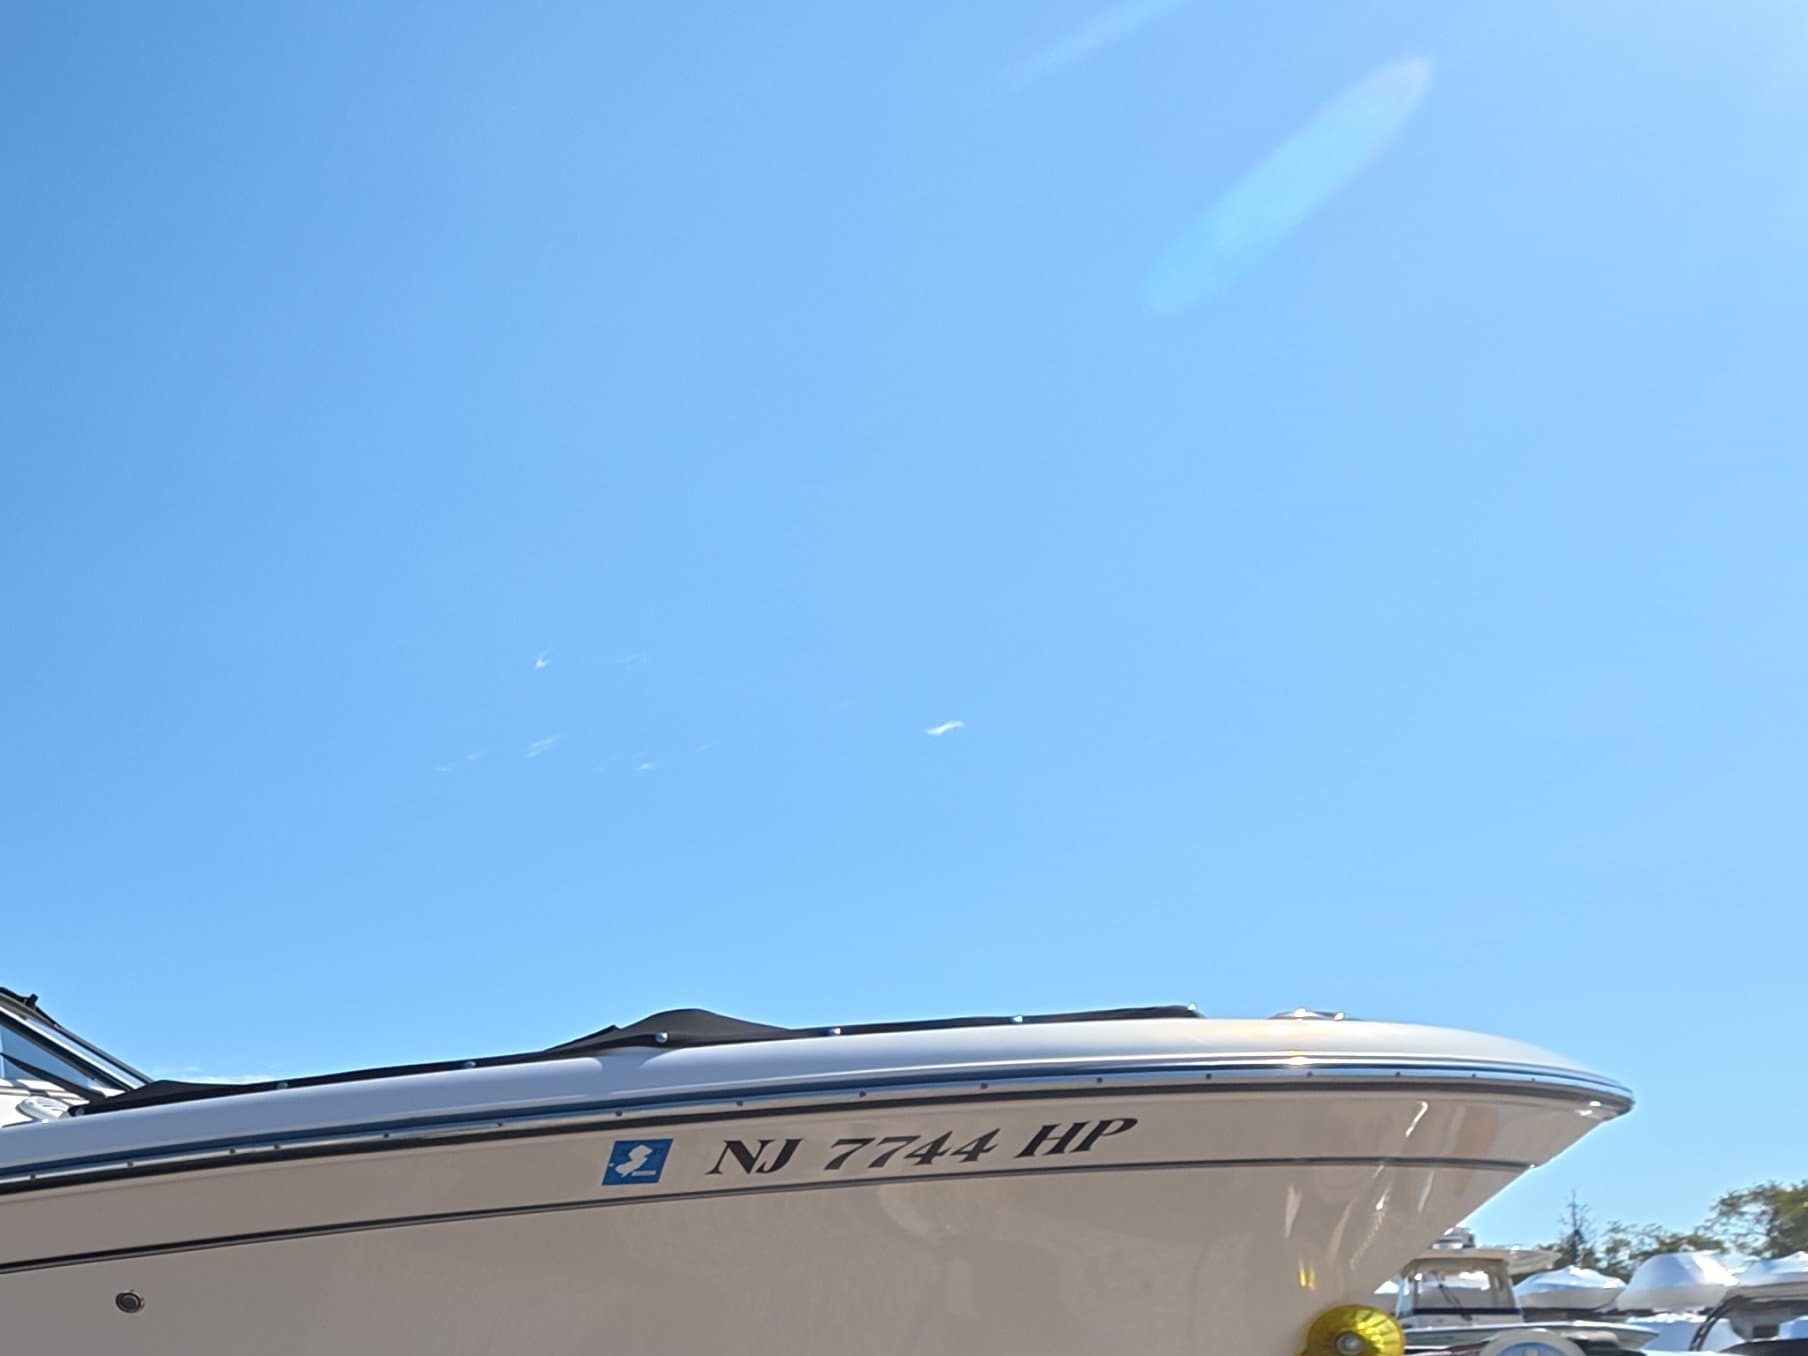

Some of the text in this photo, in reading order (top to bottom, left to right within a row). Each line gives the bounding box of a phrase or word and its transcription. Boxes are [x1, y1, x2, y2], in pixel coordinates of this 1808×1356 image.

[705, 1117, 1138, 1176] NJ 7744 HP
